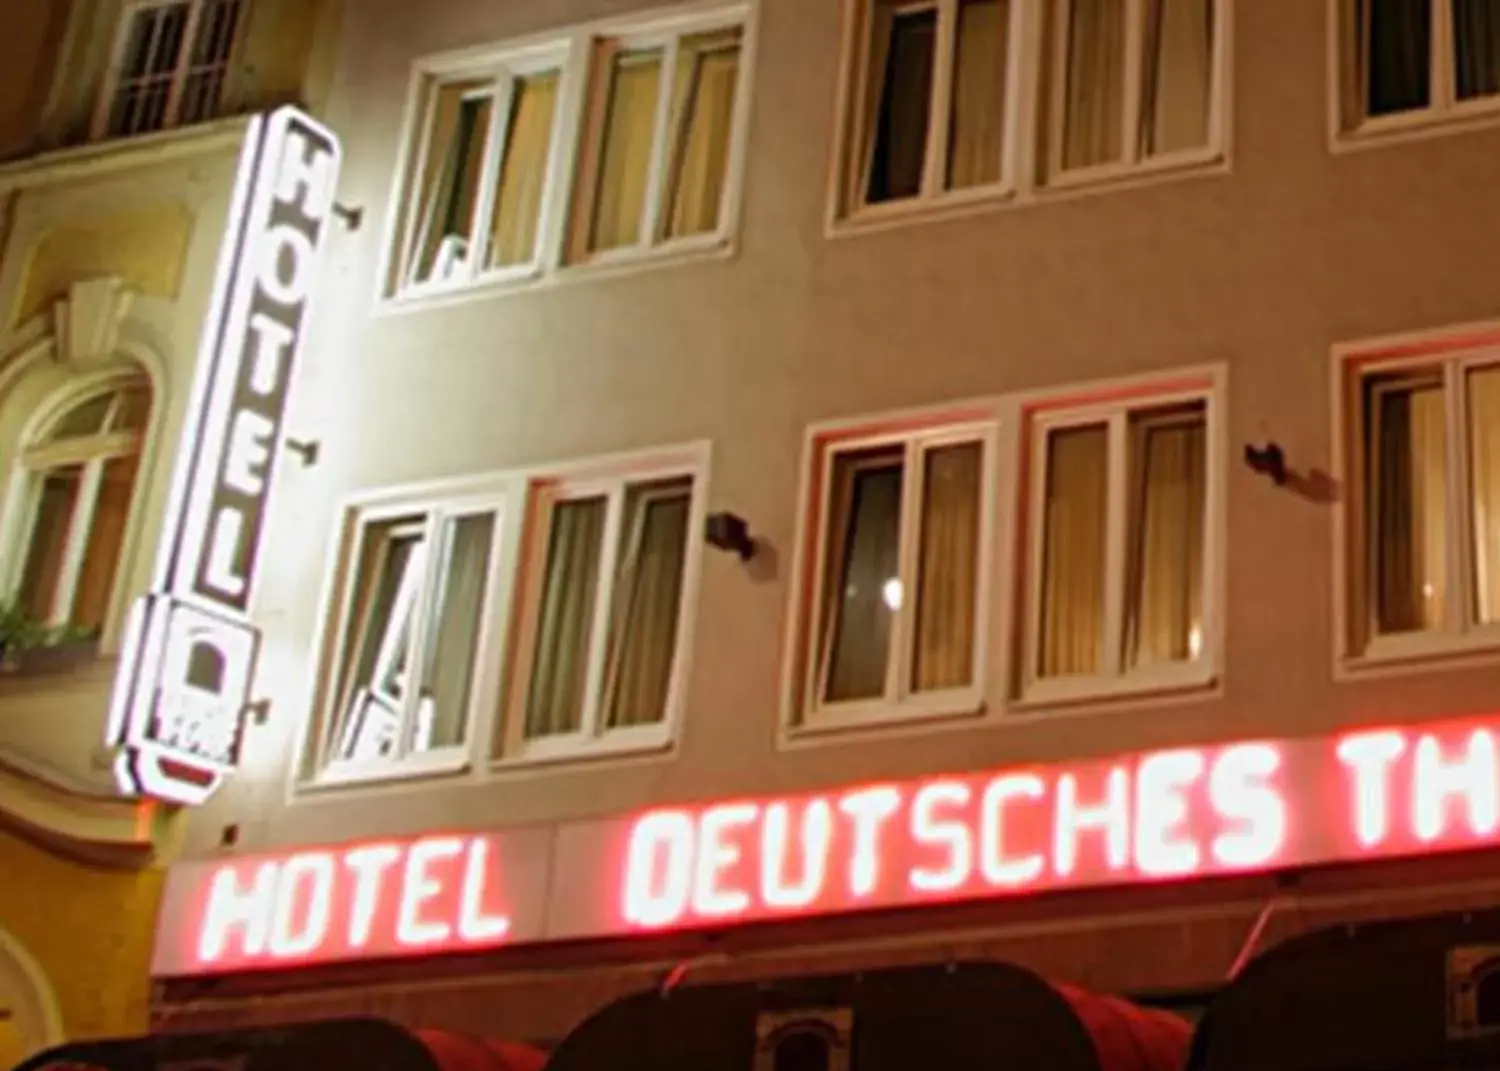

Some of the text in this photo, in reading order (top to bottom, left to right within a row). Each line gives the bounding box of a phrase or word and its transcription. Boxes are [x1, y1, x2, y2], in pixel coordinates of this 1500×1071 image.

[203, 126, 335, 598] HOTEL
[196, 836, 511, 963] HOTEL
[622, 742, 1288, 928] DEUTSCHES
